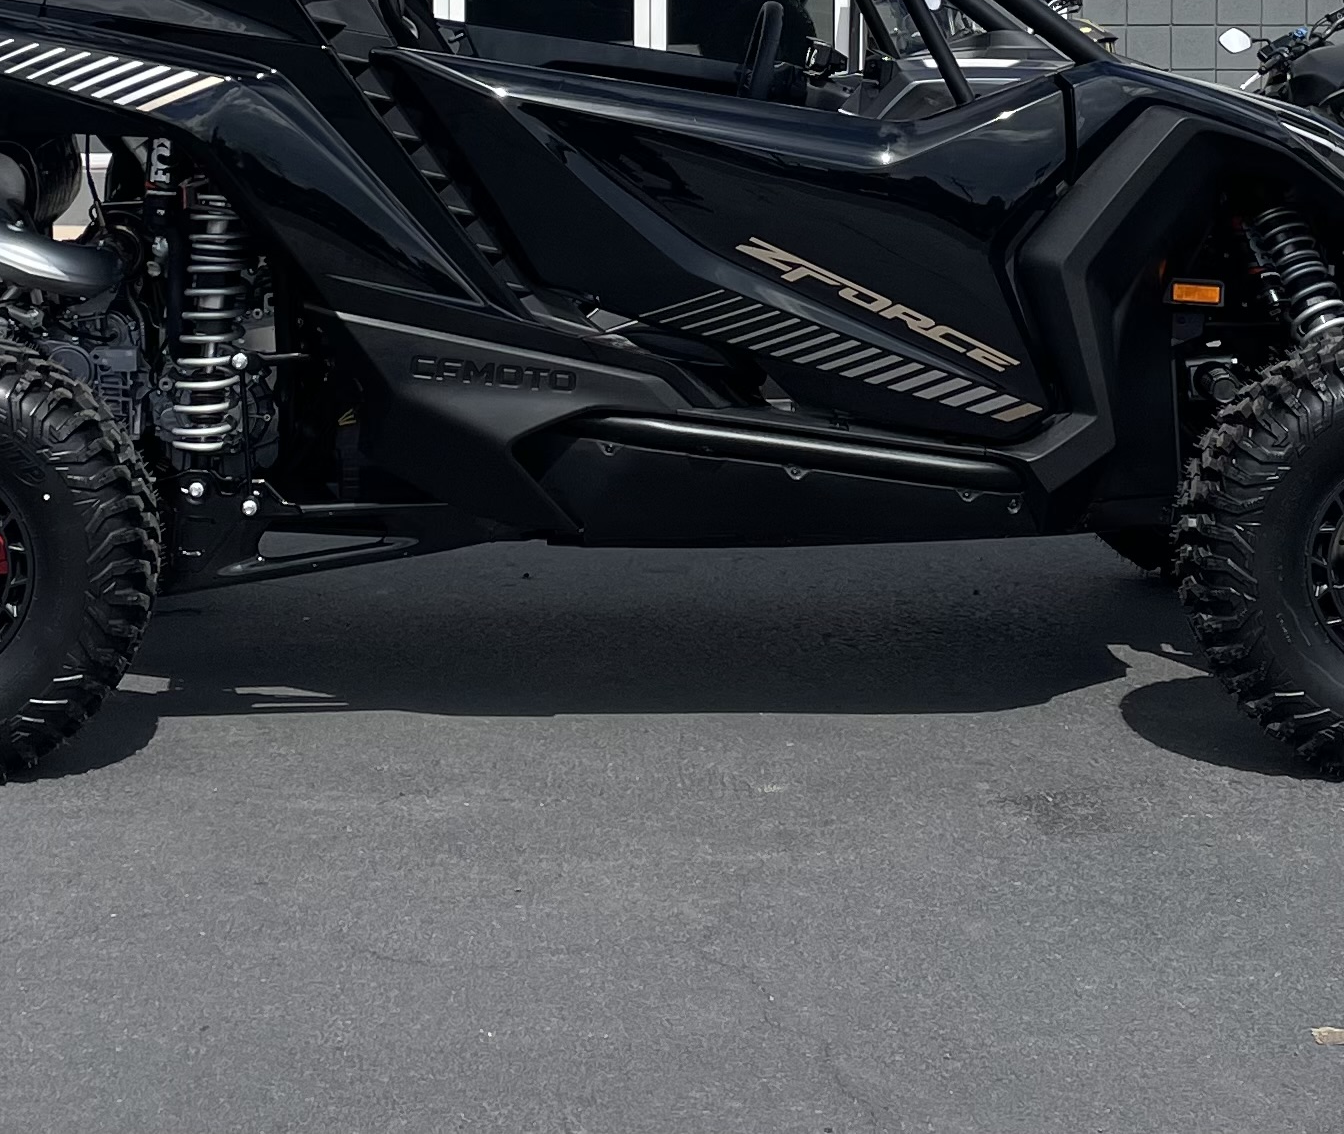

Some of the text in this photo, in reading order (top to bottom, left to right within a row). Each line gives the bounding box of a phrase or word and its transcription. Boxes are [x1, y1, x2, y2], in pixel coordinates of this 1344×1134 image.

[150, 138, 172, 183] FOX
[735, 237, 1021, 372] ZFORCE
[410, 355, 577, 394] CFMOTO
